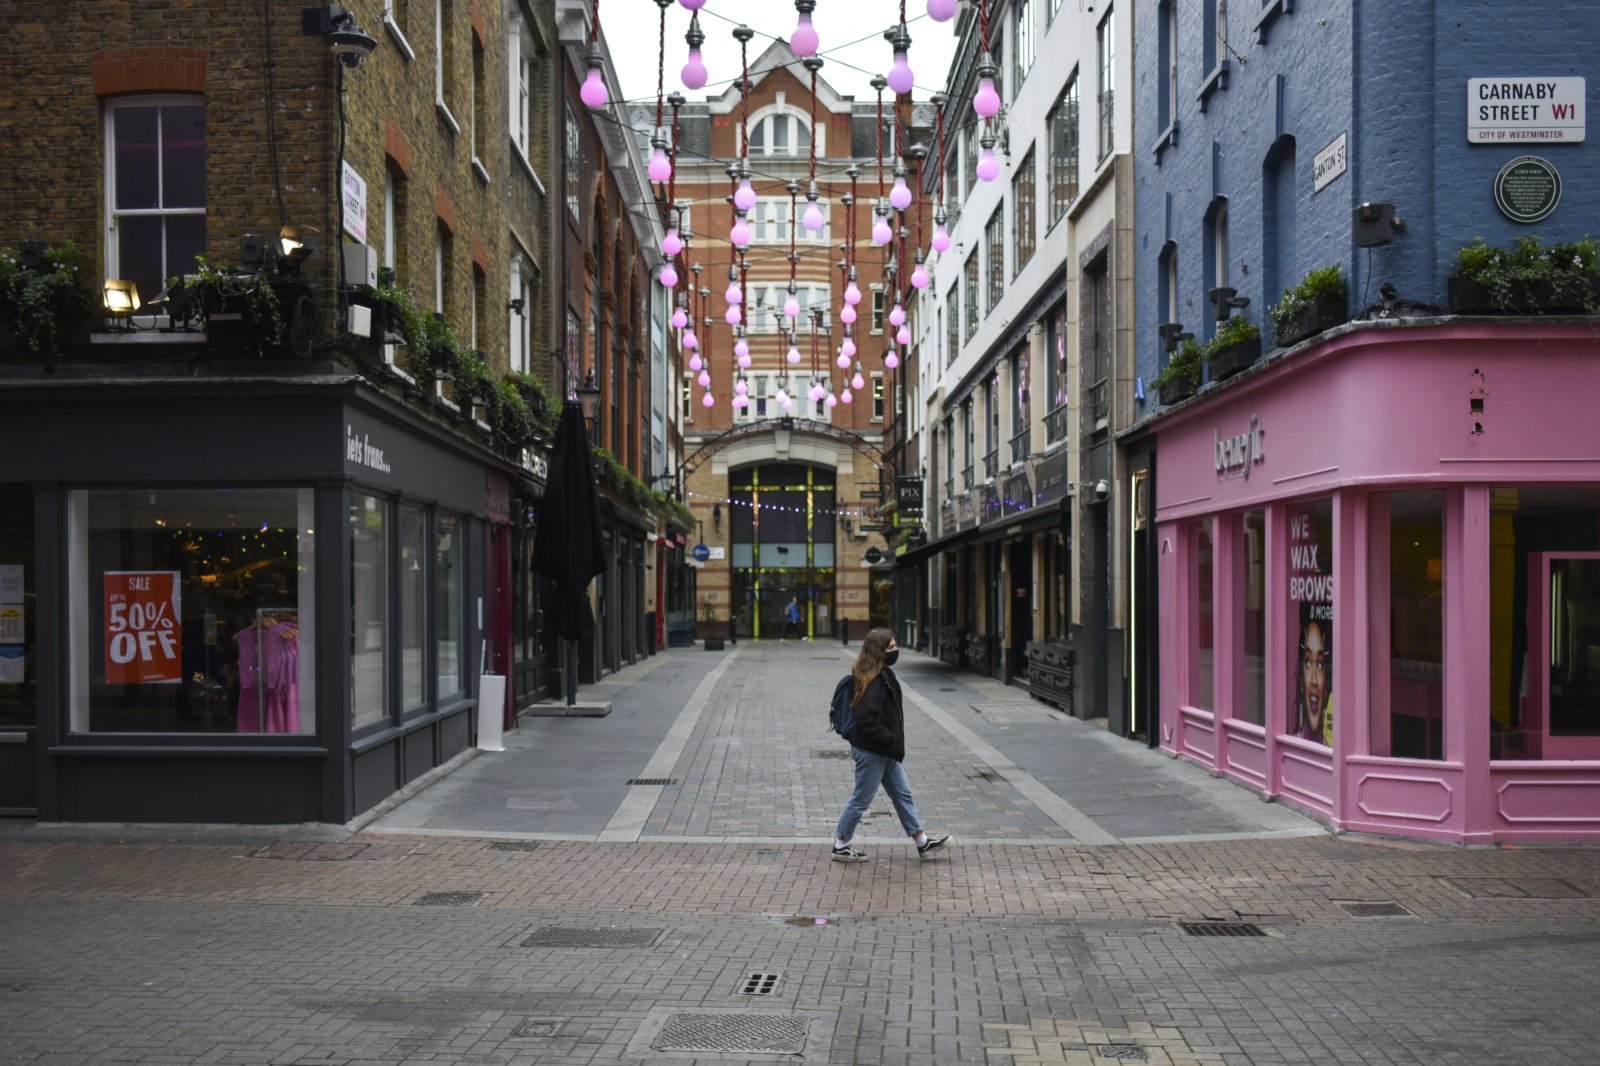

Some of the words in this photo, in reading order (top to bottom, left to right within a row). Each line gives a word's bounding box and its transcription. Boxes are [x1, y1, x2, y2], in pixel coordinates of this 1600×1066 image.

[1479, 83, 1557, 101] CARNABY
[1479, 105, 1540, 121] STREET
[1552, 103, 1576, 120] W1
[1479, 131, 1495, 139] CITY
[1497, 131, 1506, 139] OF
[1509, 130, 1563, 139] WESTMINSTER
[1314, 152, 1336, 181] GANTON
[347, 424, 363, 464] iets
[1215, 414, 1265, 480] benefit
[522, 447, 548, 480] SACRED
[900, 487, 920, 498] PIX
[1290, 514, 1309, 539] WE
[1291, 544, 1318, 570] WAX
[129, 577, 151, 590] SALE
[1290, 575, 1333, 603] BROWS
[109, 602, 174, 632] 50%
[1310, 605, 1315, 619] &
[109, 630, 177, 664] OFF
